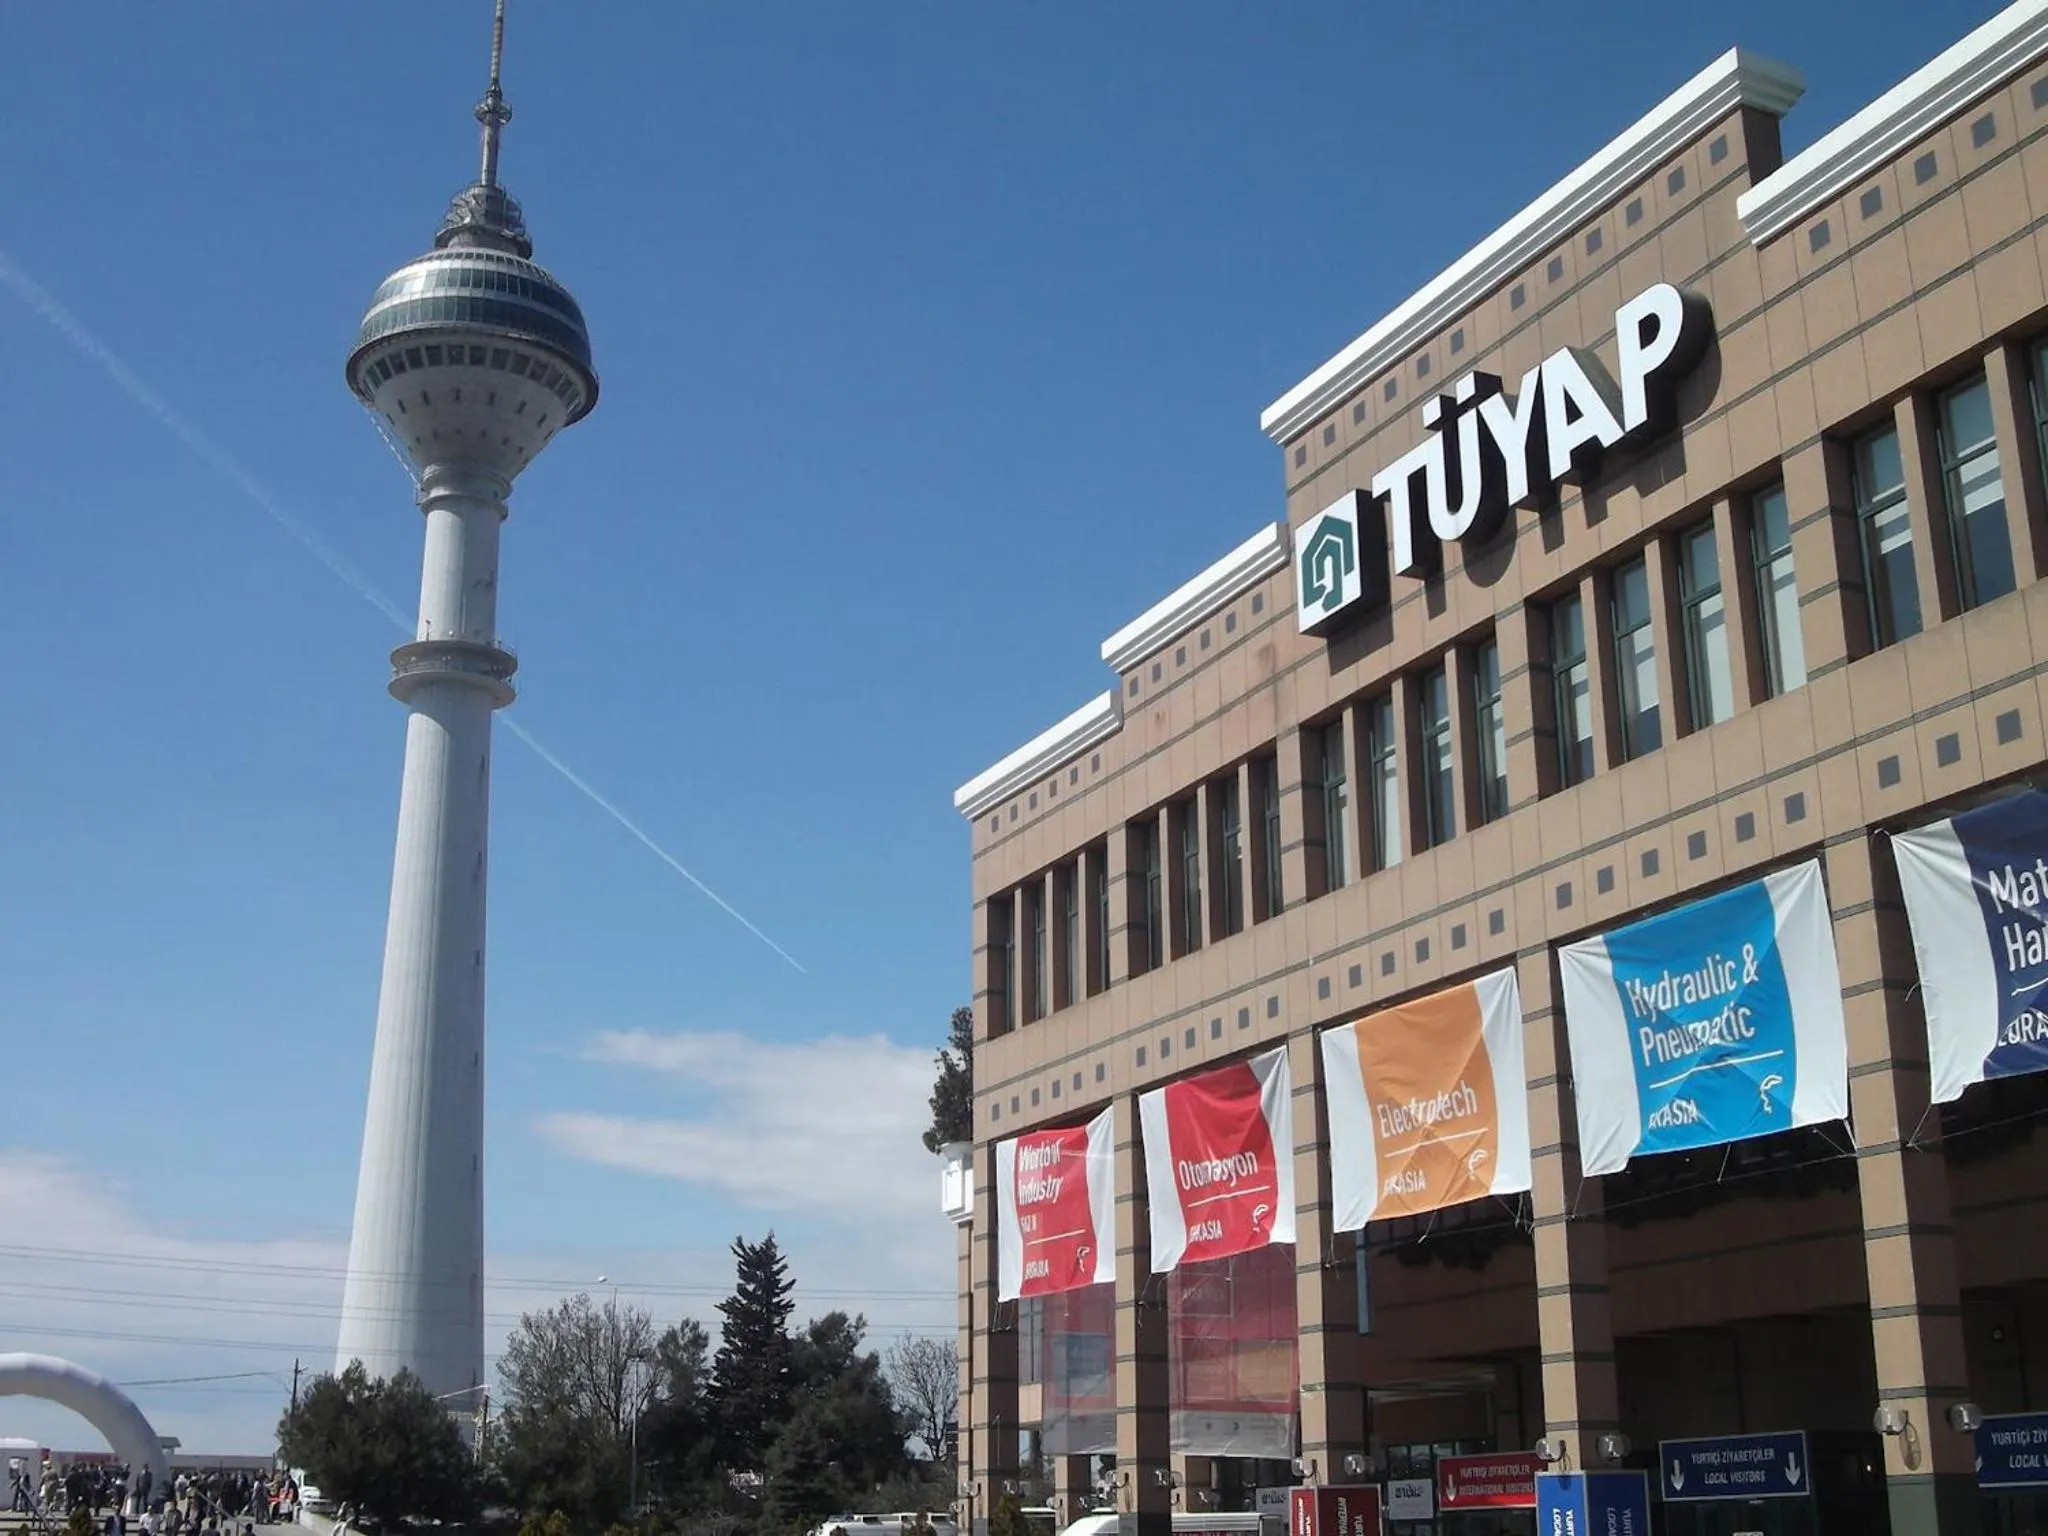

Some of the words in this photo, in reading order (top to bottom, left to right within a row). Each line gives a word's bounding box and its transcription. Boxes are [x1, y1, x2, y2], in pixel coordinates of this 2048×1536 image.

[1372, 283, 1684, 577] TÜYAP
[1625, 952, 1738, 1023] Hydraulic
[1743, 942, 1759, 984] &
[1639, 1002, 1756, 1067] Pneumatic
[1376, 1079, 1477, 1138] Electrotech
[1179, 1151, 1258, 1190] Otomasyon
[1704, 1472, 1728, 1485] LOCAL
[1730, 1470, 1766, 1484] VISITORS
[2009, 1454, 2041, 1469] LOCAL
